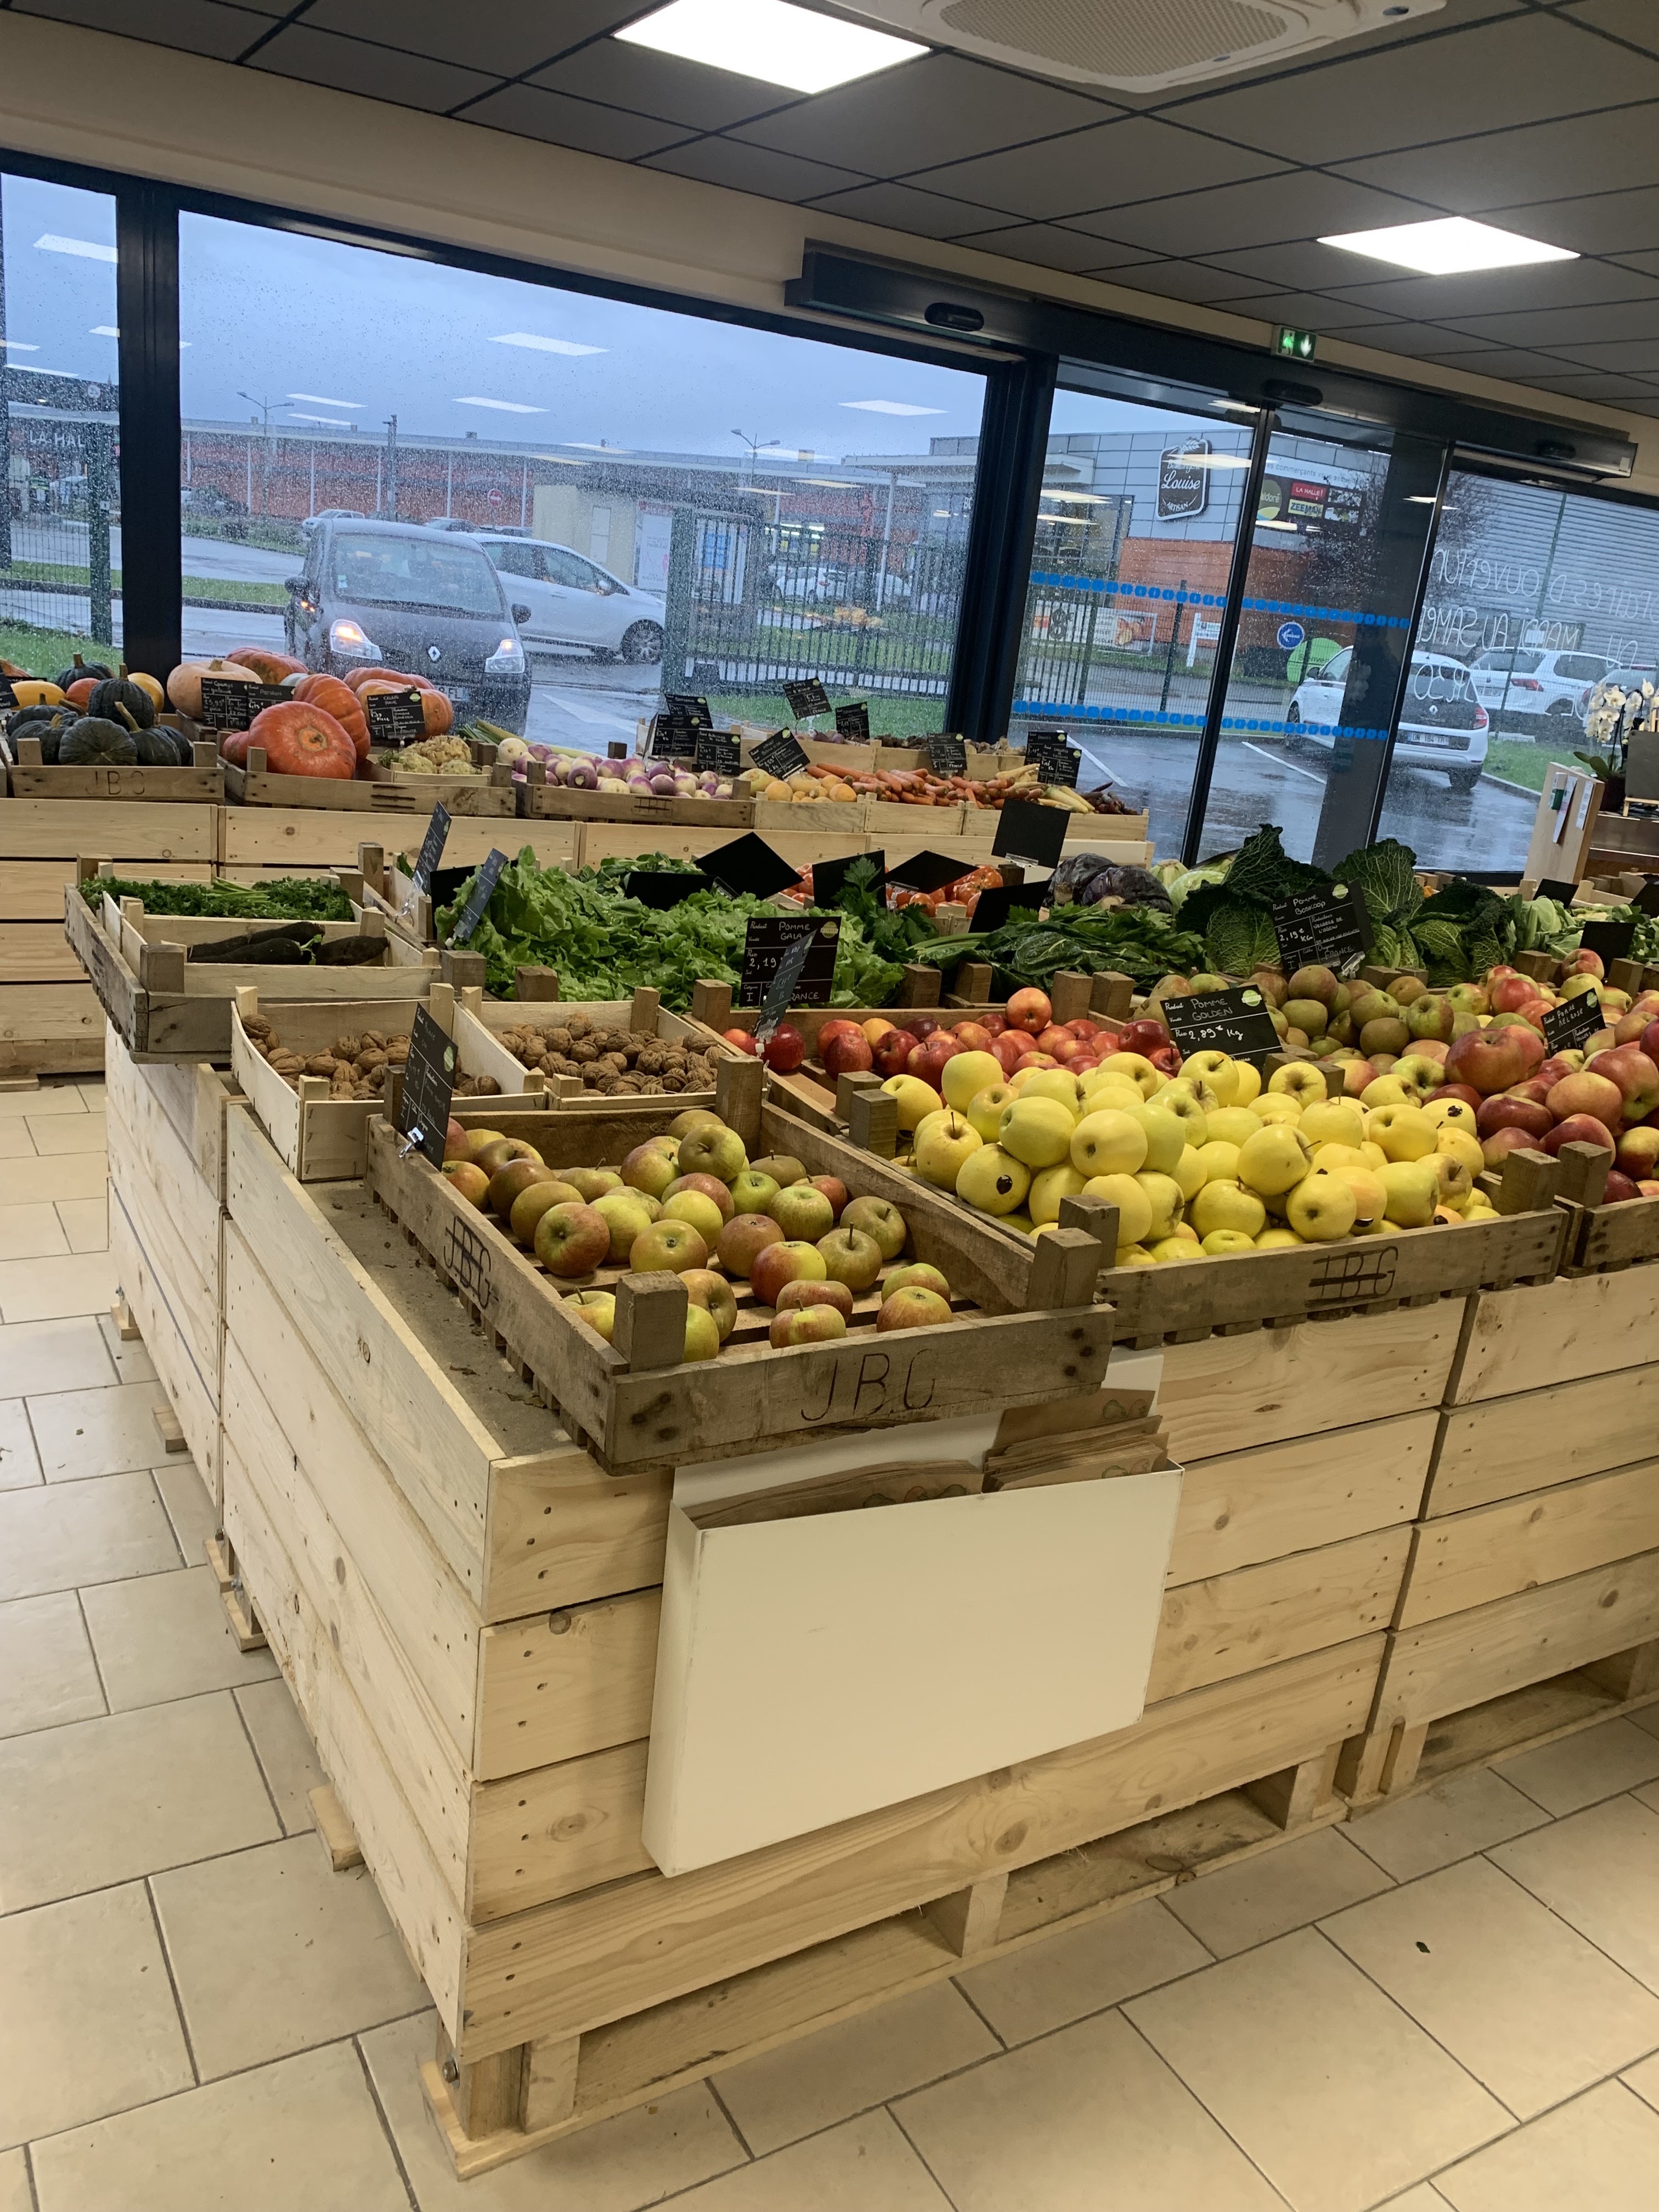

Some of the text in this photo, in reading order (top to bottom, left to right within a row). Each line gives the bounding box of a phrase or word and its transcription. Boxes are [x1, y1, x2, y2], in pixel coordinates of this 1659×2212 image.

[54, 432, 86, 448] HAL
[1276, 464, 1317, 478] commerçants
[1161, 470, 1201, 490] Louise
[1260, 493, 1280, 503] aldoré
[1166, 501, 1189, 512] ARTISAN
[1290, 502, 1323, 515] ZEEMAN
[1293, 894, 1319, 907] POMME
[778, 921, 810, 931] POMME
[1324, 946, 1355, 960] FRANCE
[789, 992, 820, 1002] RANCE
[1164, 997, 1229, 1011] Produit POMME
[1192, 1007, 1234, 1022] GOLDEN
[1556, 1004, 1576, 1019] POMME
[1175, 1029, 1188, 1039] Prix
